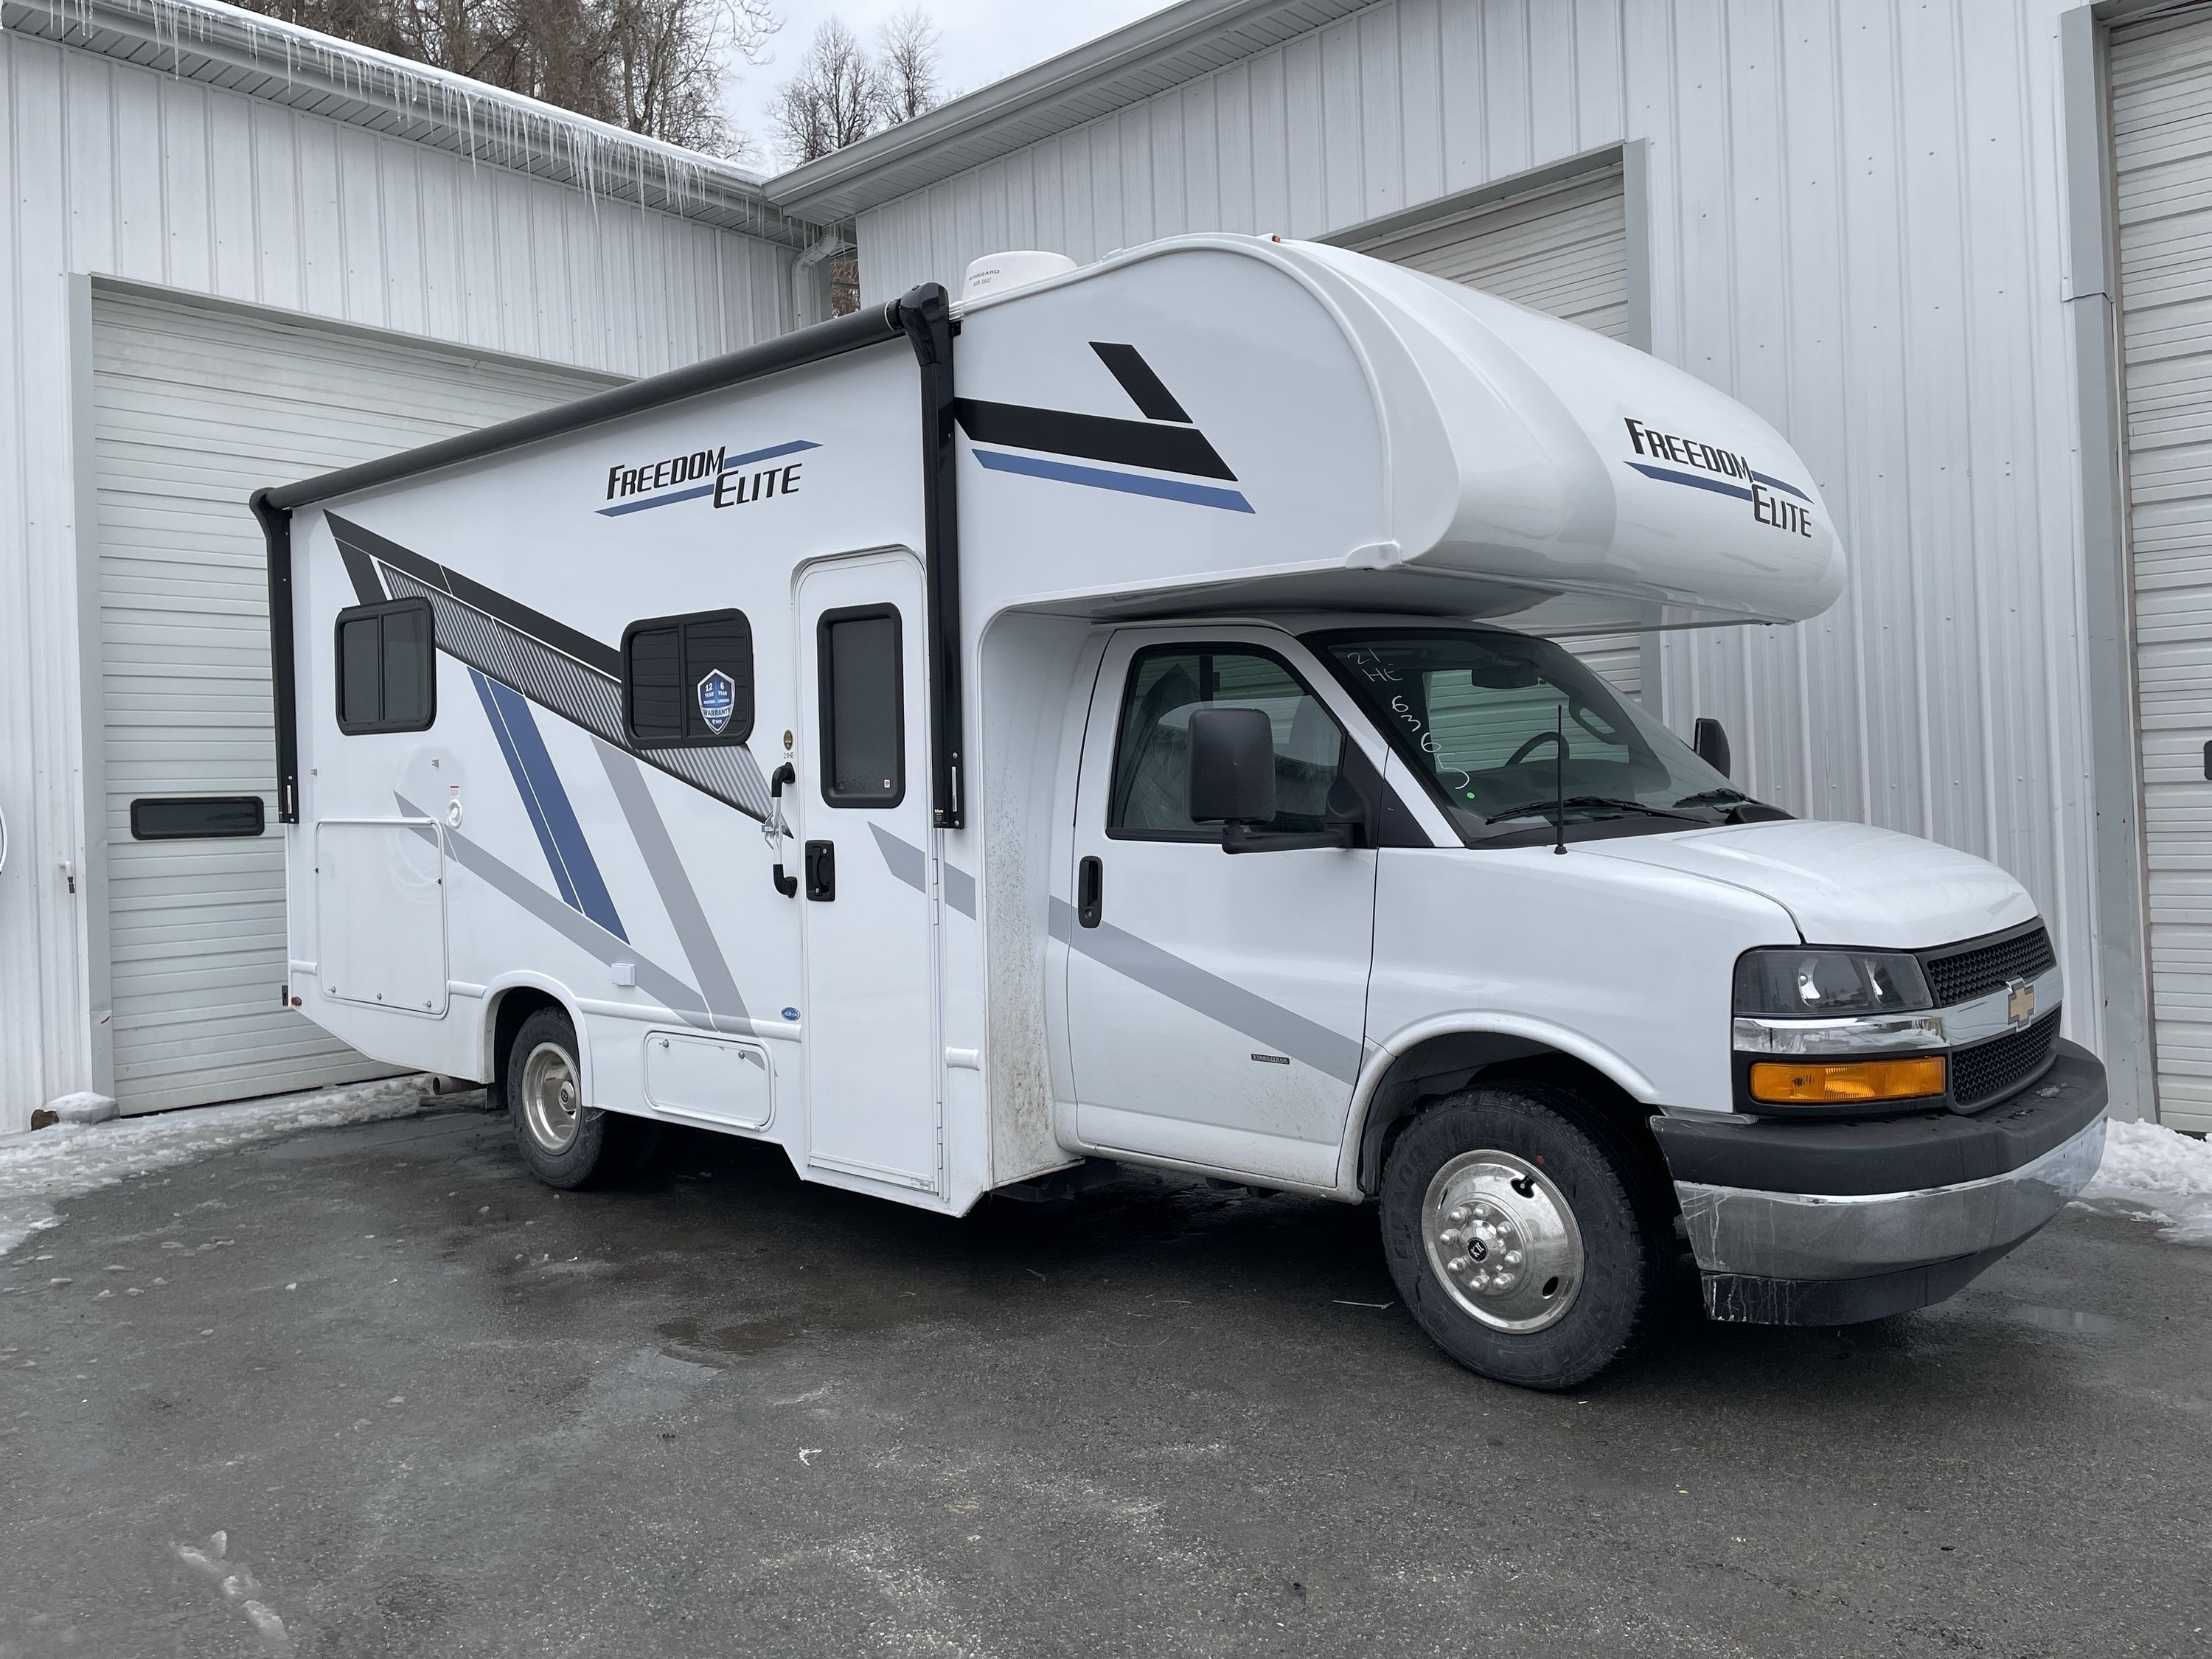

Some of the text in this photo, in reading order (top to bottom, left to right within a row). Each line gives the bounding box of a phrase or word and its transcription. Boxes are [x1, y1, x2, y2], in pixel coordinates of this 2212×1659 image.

[1624, 417, 1754, 484] FREEDOM
[606, 446, 726, 500] FREEDOM
[713, 462, 802, 509] ELITE
[1751, 484, 1812, 538] ELITE
[1347, 648, 1381, 666] 21
[1361, 663, 1404, 683] HE
[705, 683, 713, 692] 12
[720, 681, 725, 690] 6
[703, 707, 731, 717] WARRANTY
